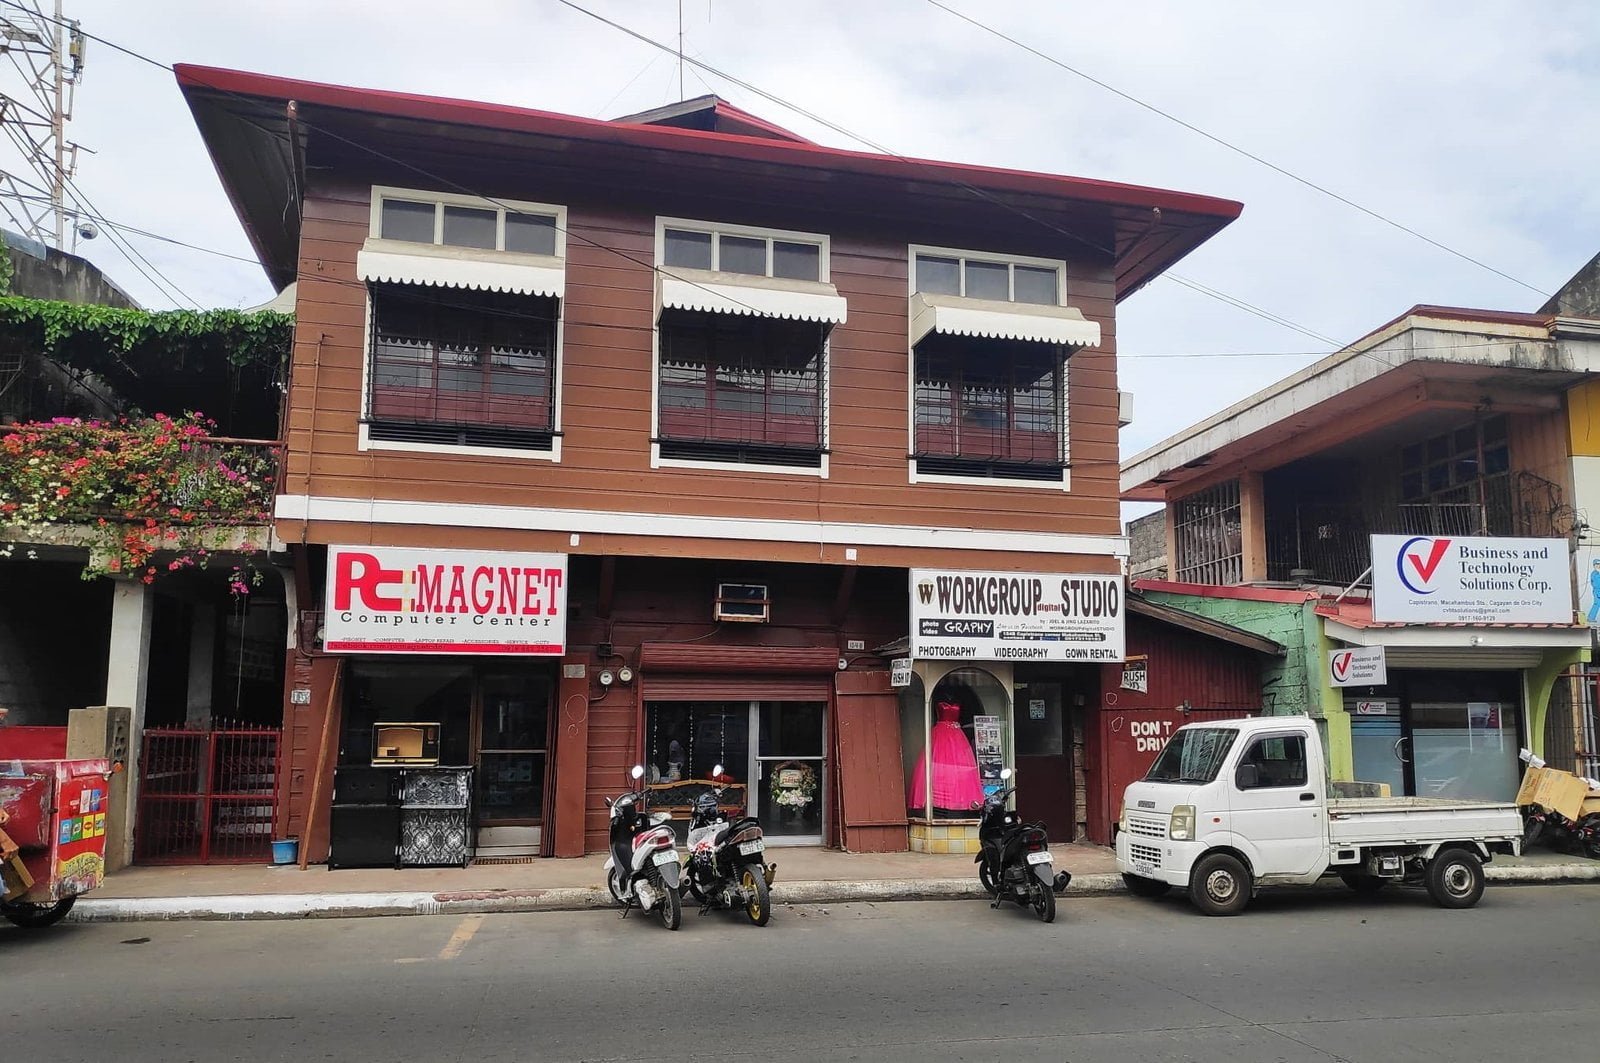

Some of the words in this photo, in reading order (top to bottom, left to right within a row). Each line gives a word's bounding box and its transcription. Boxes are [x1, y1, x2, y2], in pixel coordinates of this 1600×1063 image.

[1459, 545, 1519, 560] Business
[1522, 546, 1548, 560] and
[1458, 561, 1535, 577] Technology
[416, 564, 562, 616] MAGNET
[1459, 577, 1515, 591] Solutions
[1517, 579, 1552, 594] Corp.
[936, 575, 1043, 616] WORKGROUP
[1037, 602, 1062, 613] digital
[1061, 579, 1119, 618] STUDIO
[1489, 600, 1512, 608] Cagayan
[1531, 600, 1543, 608] City
[340, 612, 458, 627] Computer
[472, 614, 552, 628] Center
[922, 620, 940, 628] photo
[944, 621, 993, 634] GRAPHY
[918, 646, 977, 657] PHOTOGRAPHY
[993, 647, 1049, 658] VIDEOGRAPHY
[1065, 648, 1089, 659] GOWN
[1089, 649, 1119, 660] RENTAL
[1123, 671, 1146, 682] RUSH
[1136, 737, 1171, 752] DRIV
